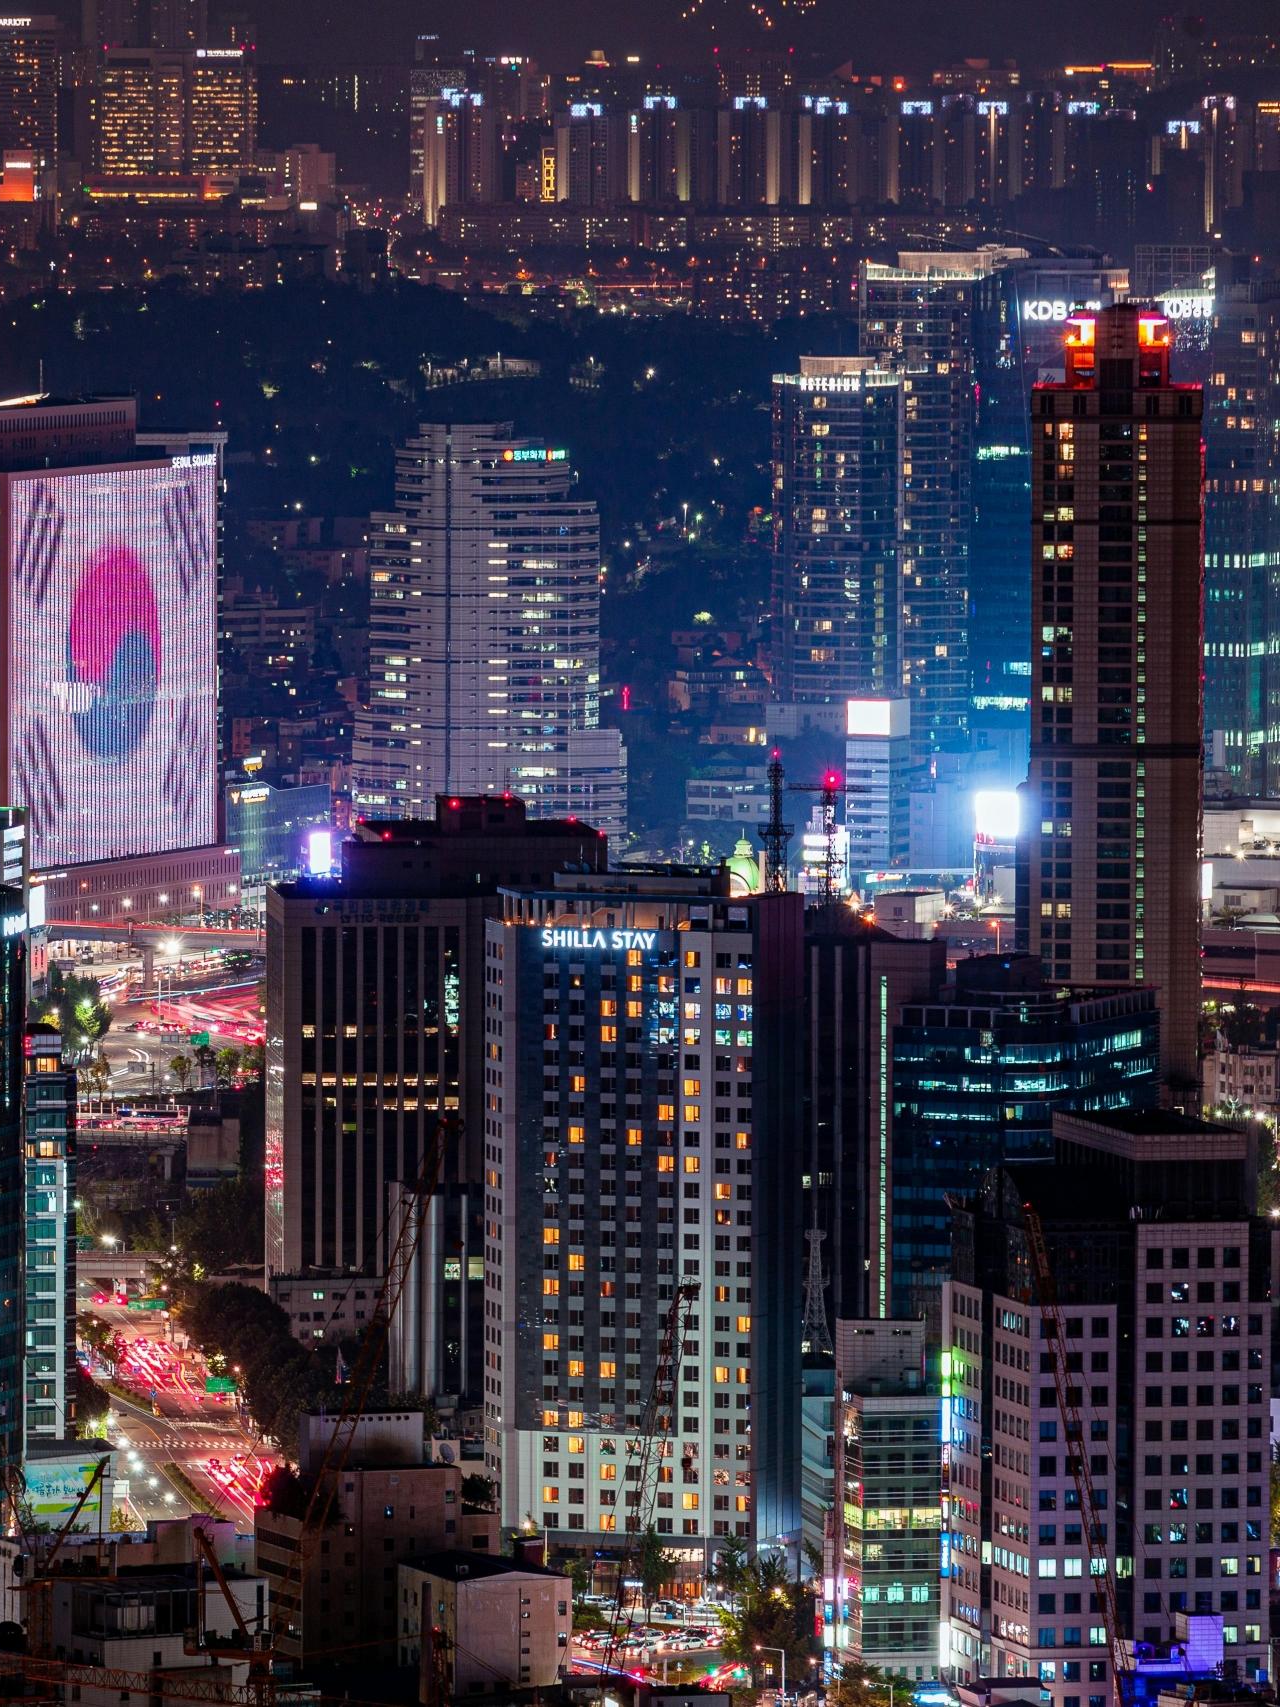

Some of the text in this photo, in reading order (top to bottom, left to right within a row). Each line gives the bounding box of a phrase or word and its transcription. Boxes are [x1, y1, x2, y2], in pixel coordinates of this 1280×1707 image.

[172, 453, 217, 468] SEOUL SQUARE
[513, 450, 547, 461] 동부화재
[542, 929, 656, 950] SHILLA STAY
